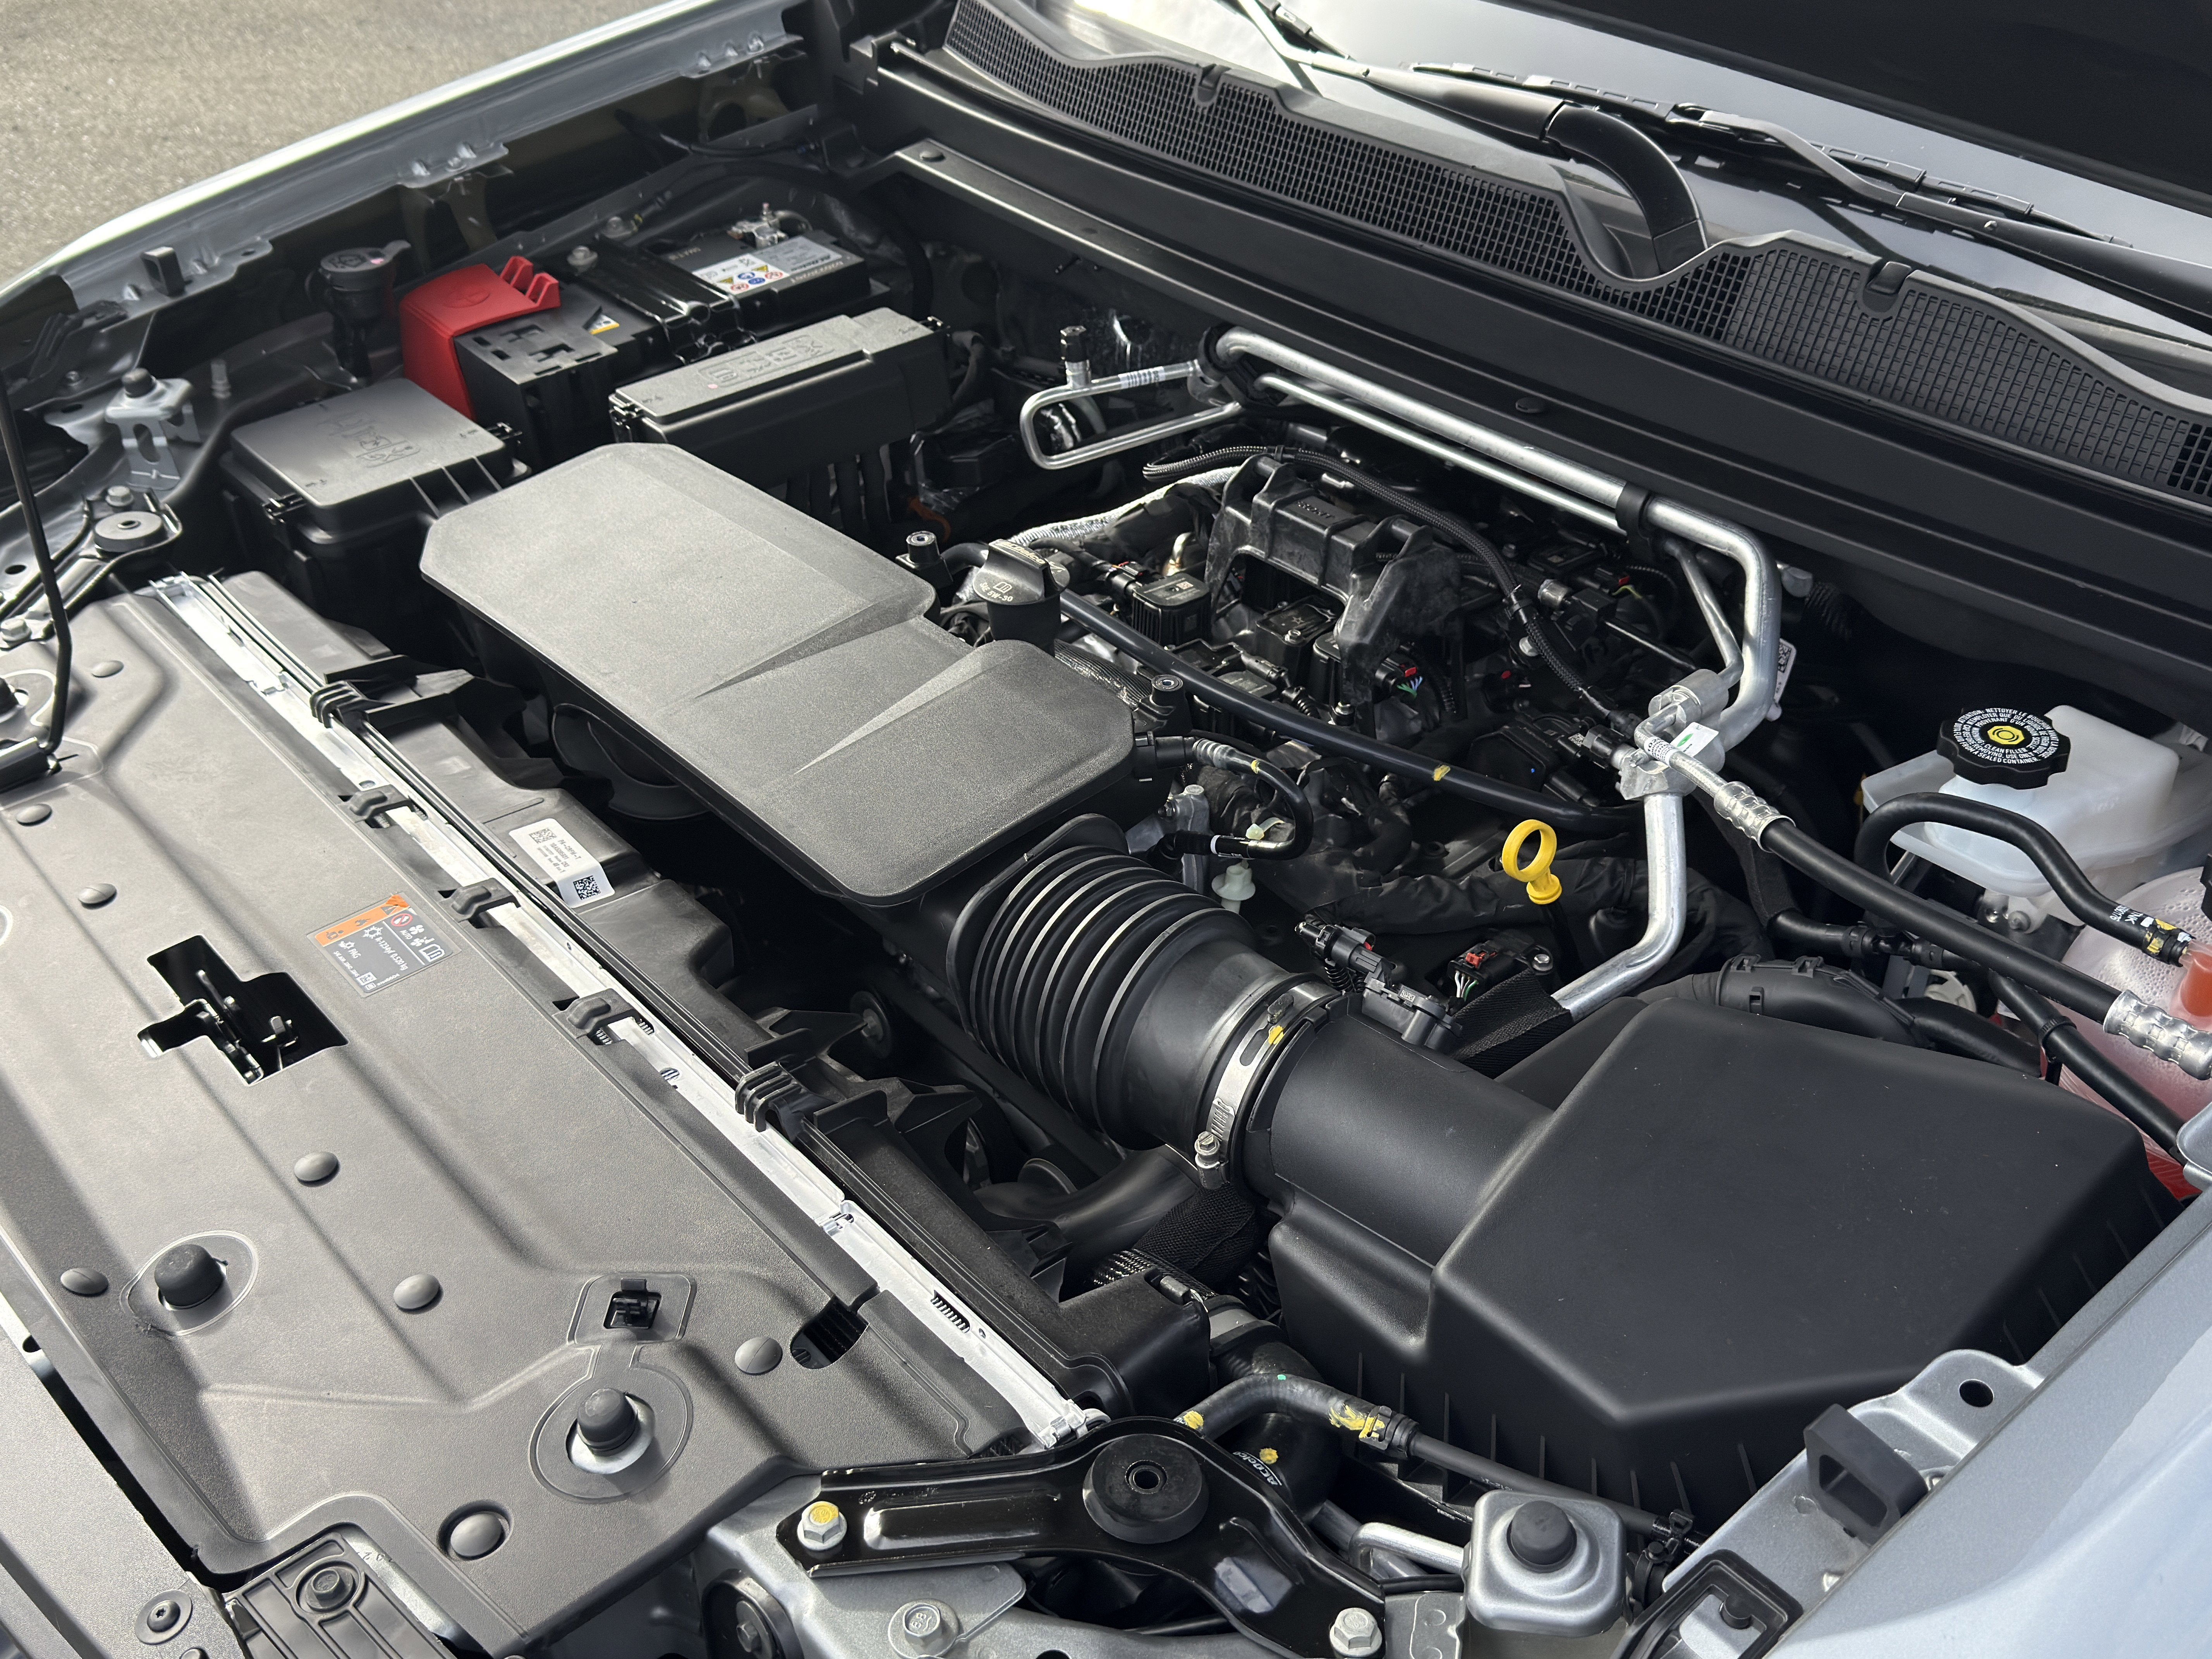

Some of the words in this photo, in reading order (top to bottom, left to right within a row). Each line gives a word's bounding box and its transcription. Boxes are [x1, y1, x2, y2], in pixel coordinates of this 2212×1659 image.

[979, 582, 991, 592] SAE
[1958, 710, 1985, 723] ATTENTION:
[2027, 714, 2052, 730] BOUCHON
[2047, 730, 2059, 741] AVANT
[1975, 718, 2008, 727] PROVENANT
[2024, 725, 2039, 736] BIDON
[2023, 718, 2044, 731] LIQUIDE
[2040, 736, 2049, 746] FREIN
[1954, 732, 1965, 742] FLUID
[1960, 742, 1976, 752] FROM
[1978, 752, 2002, 763] SEALED
[1963, 731, 1976, 745] BEFORE
[1972, 744, 2004, 758] REMOVING.
[1984, 744, 2004, 753] CLEAN
[400, 930, 412, 939] AUTO
[348, 949, 361, 958] PAG
[375, 937, 395, 954] R-1234yf
[390, 953, 405, 965] 0.520
[1233, 1451, 1278, 1486] ACDelco
